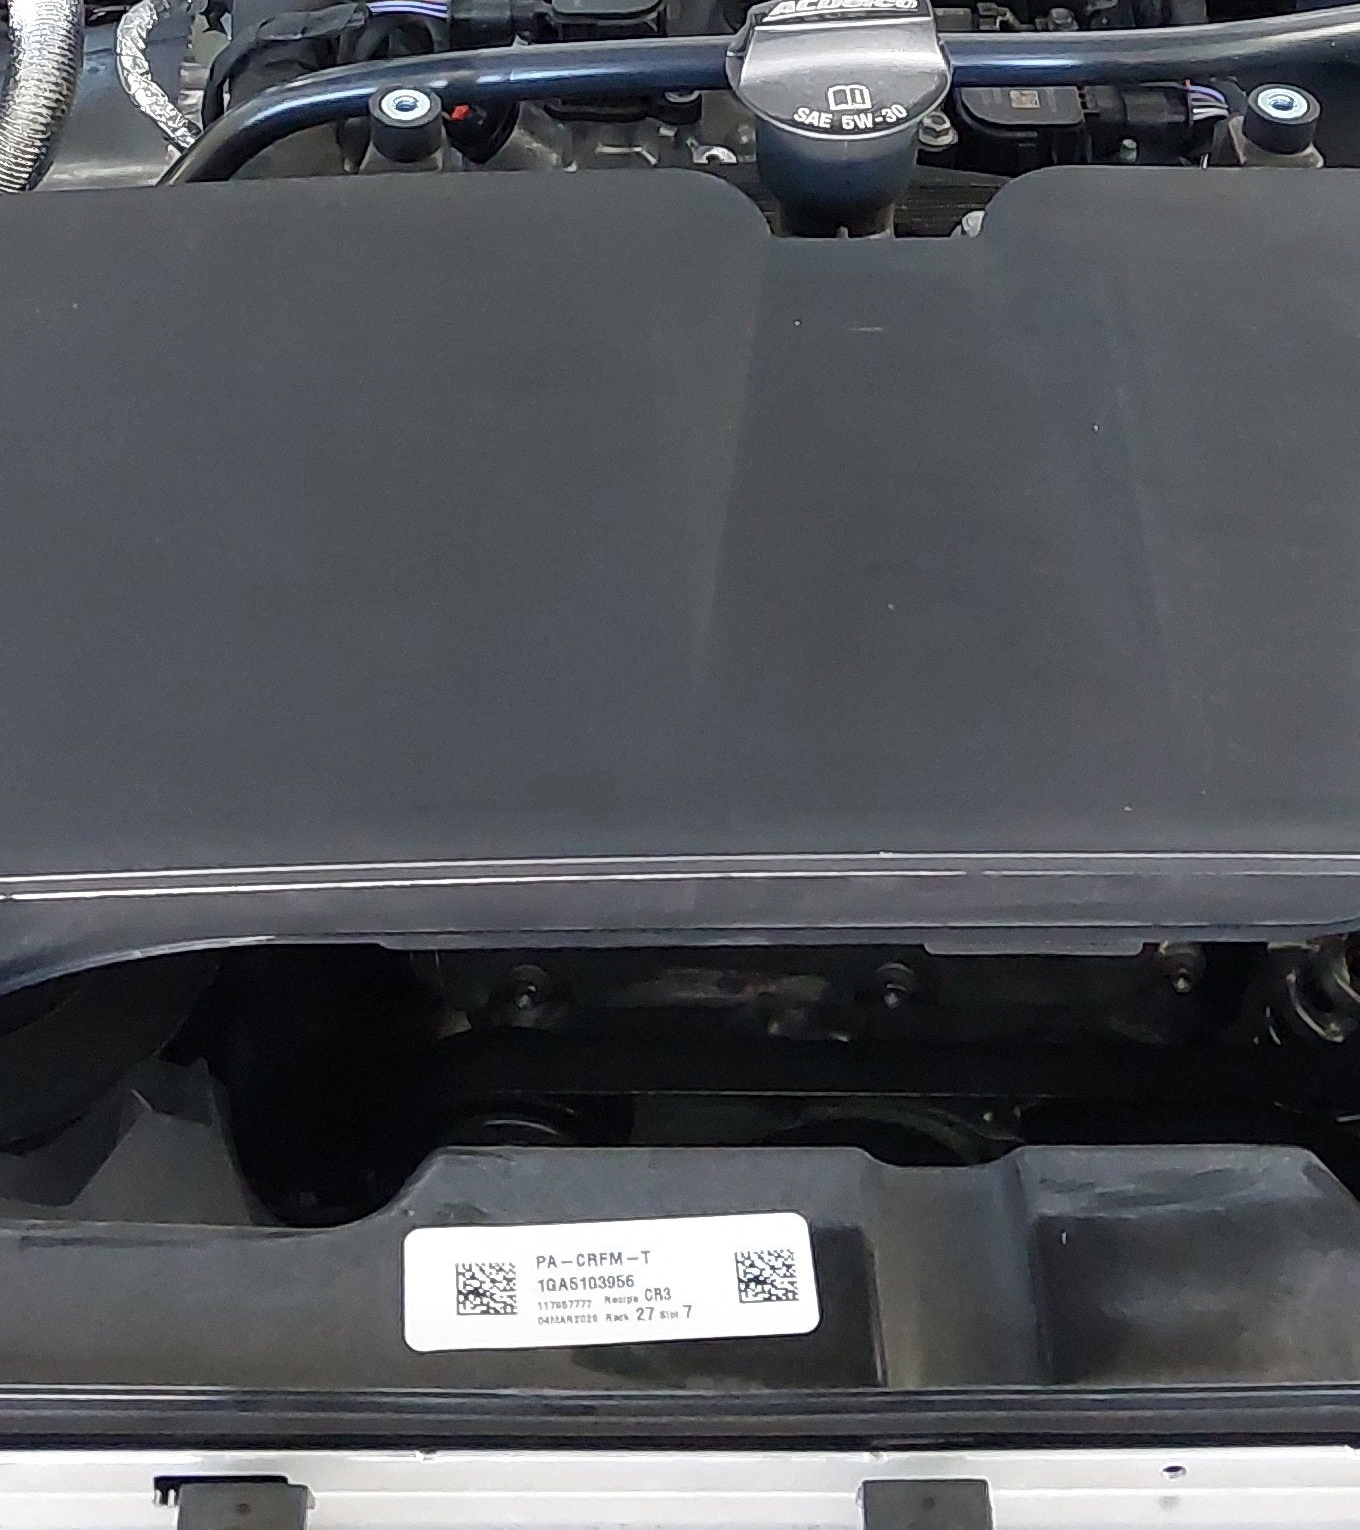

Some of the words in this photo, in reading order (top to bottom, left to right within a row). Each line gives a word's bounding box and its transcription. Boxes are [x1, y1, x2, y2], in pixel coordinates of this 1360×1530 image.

[793, 107, 834, 129] SAE
[841, 104, 909, 130] 5W-30
[644, 1287, 672, 1302] CR3
[635, 1306, 655, 1321] 27
[682, 1304, 693, 1319] 7
